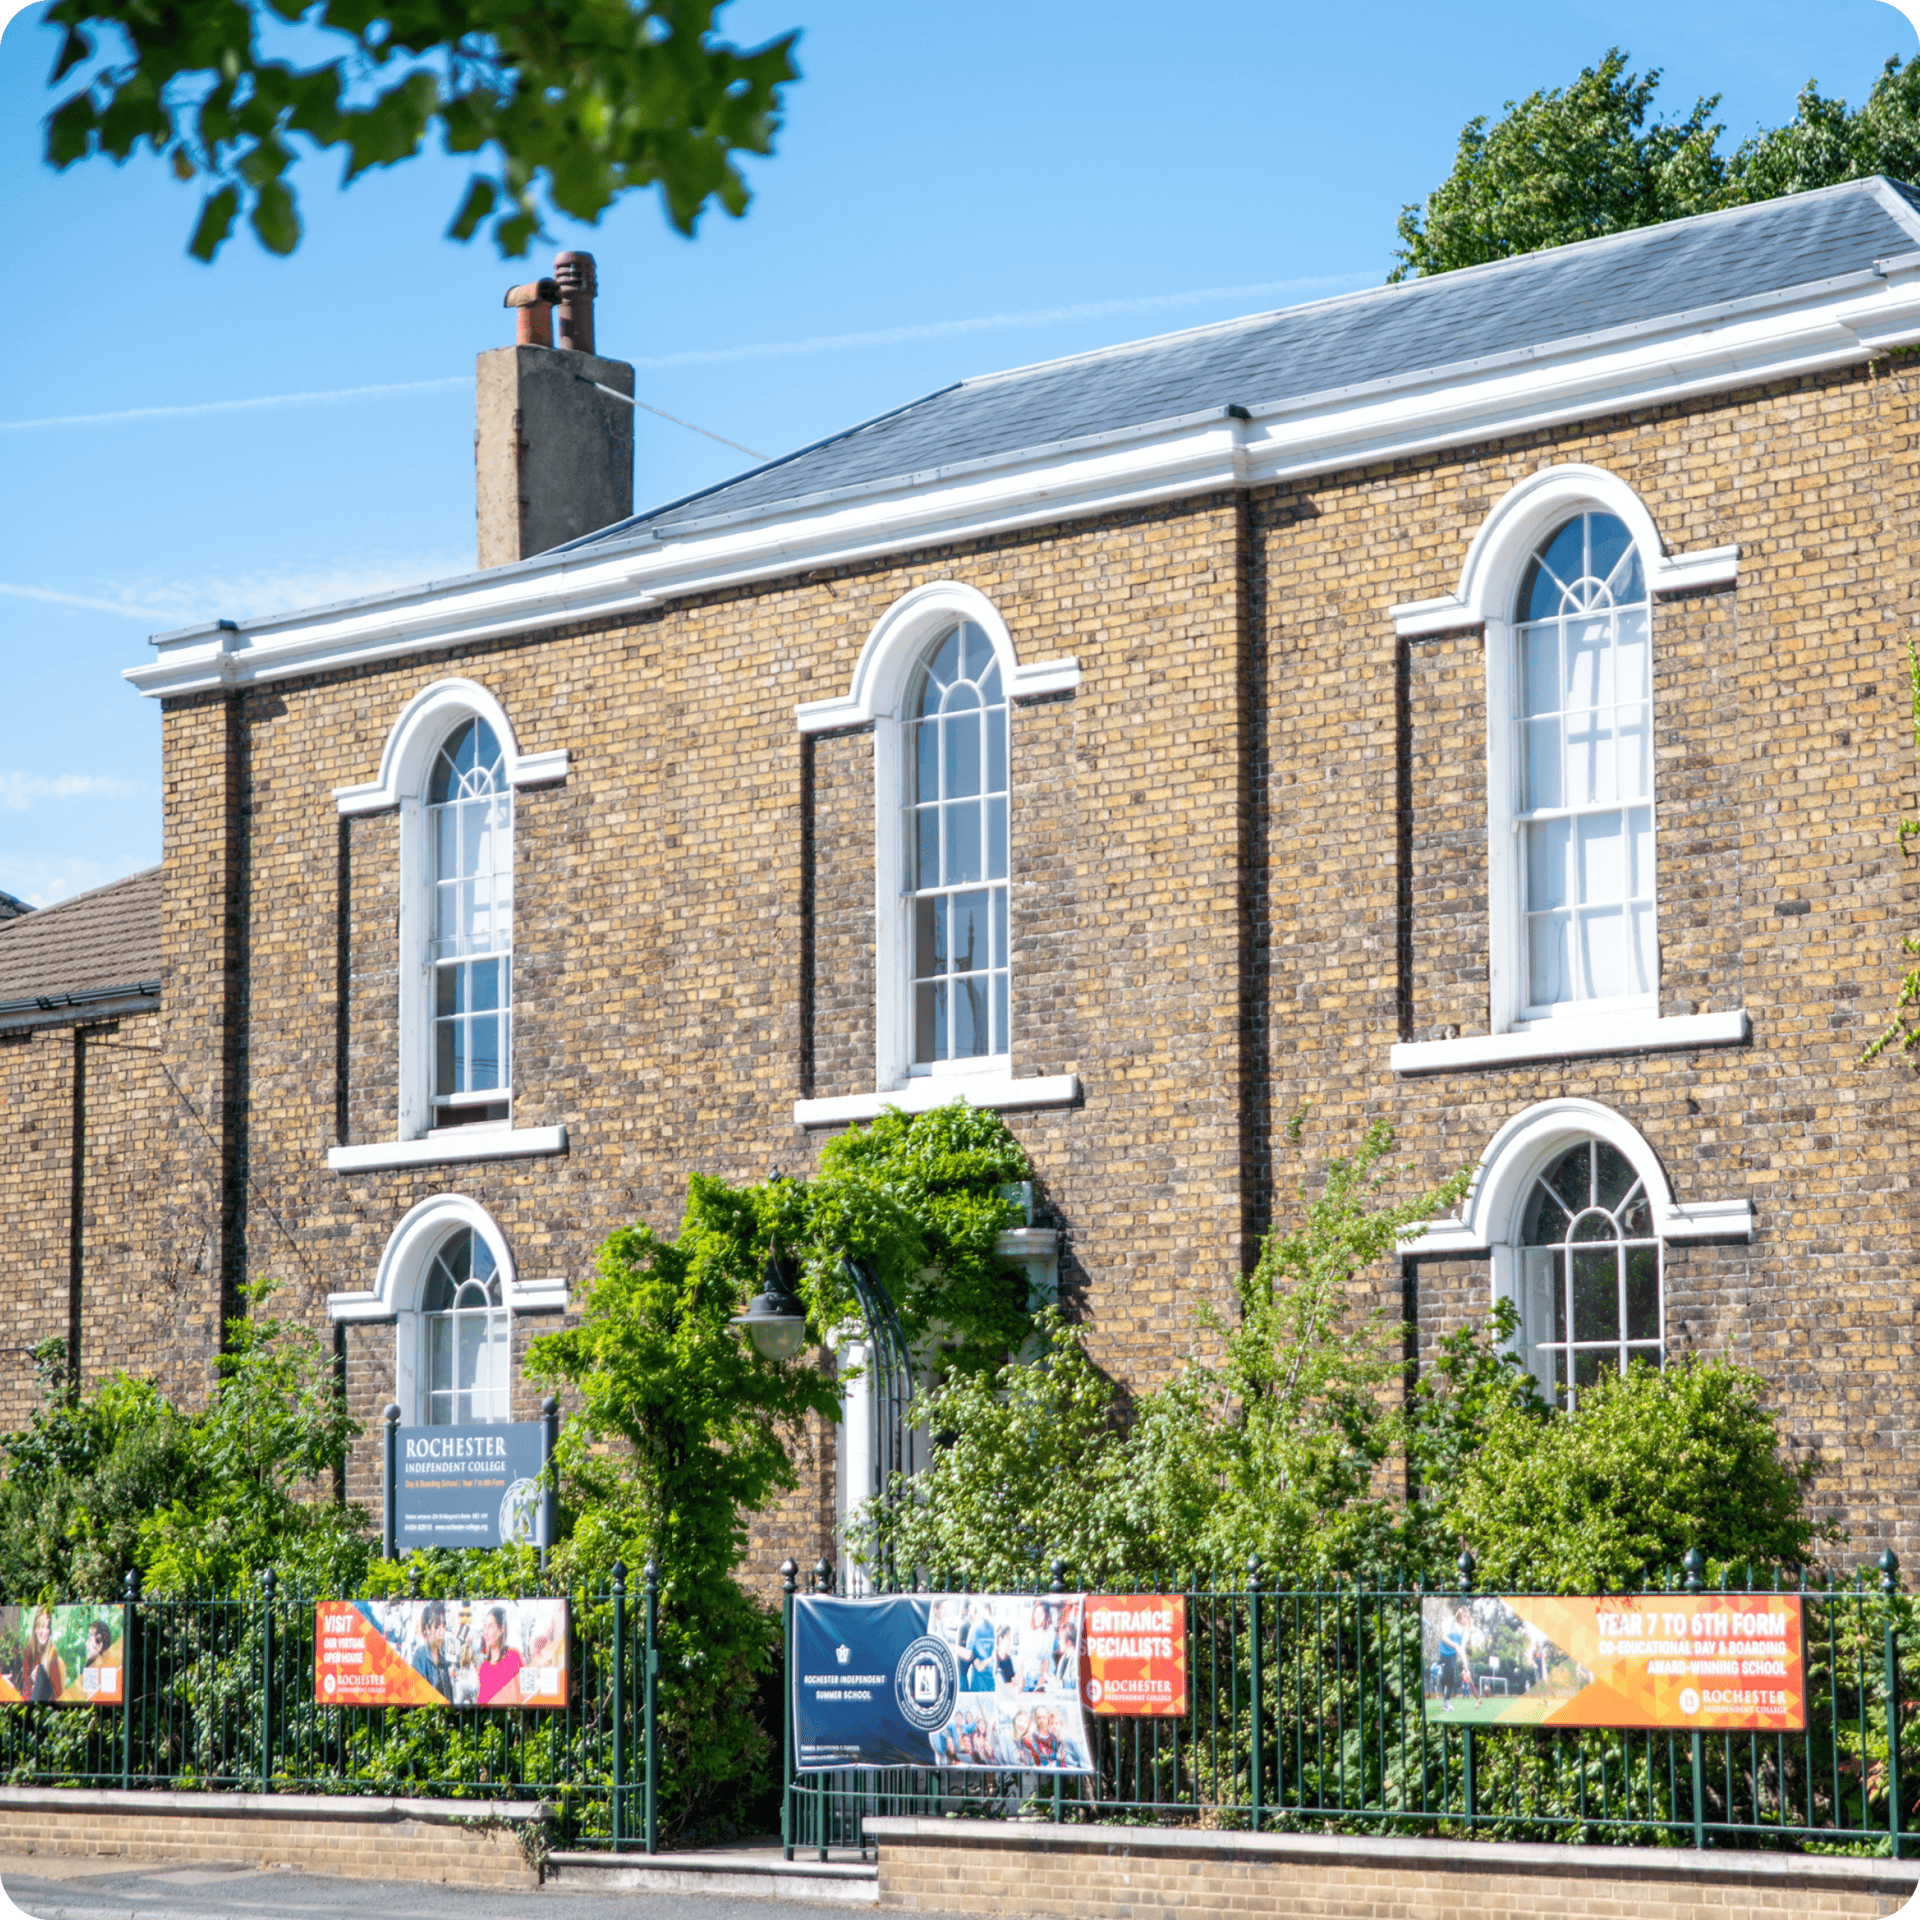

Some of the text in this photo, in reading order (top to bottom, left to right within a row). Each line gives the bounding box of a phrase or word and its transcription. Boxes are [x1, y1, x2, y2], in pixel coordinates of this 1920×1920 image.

[406, 1437, 507, 1458] ROCHESTER
[405, 1461, 506, 1473] INDEPENDENT COLLEGE
[420, 1480, 440, 1489] Boarding
[441, 1479, 458, 1488] School
[462, 1479, 473, 1488] Year
[492, 1478, 505, 1488] Form
[324, 1615, 353, 1633] VISIT
[1092, 1611, 1171, 1631] ENTRANCE
[1596, 1613, 1785, 1636] YEAR 7 TO 6TH FORM
[324, 1637, 365, 1649] OUR VIRTUAL
[1599, 1640, 1786, 1655] CO-EDUCATIONAL DAY & BOARDING
[324, 1652, 364, 1664] OPEN HOUSE
[1647, 1660, 1787, 1675] AWARD-WINNING SCHOOL
[337, 1674, 386, 1685] ROCHESTER
[804, 1675, 885, 1684] ROCHESTER INDEPENDENT
[1104, 1680, 1172, 1692] ROCHESTER
[816, 1690, 872, 1699] SUMMER SCHOOL
[1702, 1689, 1787, 1704] ROCHESTER
[1703, 1706, 1787, 1714] INDEPENDENT COLLEGE
